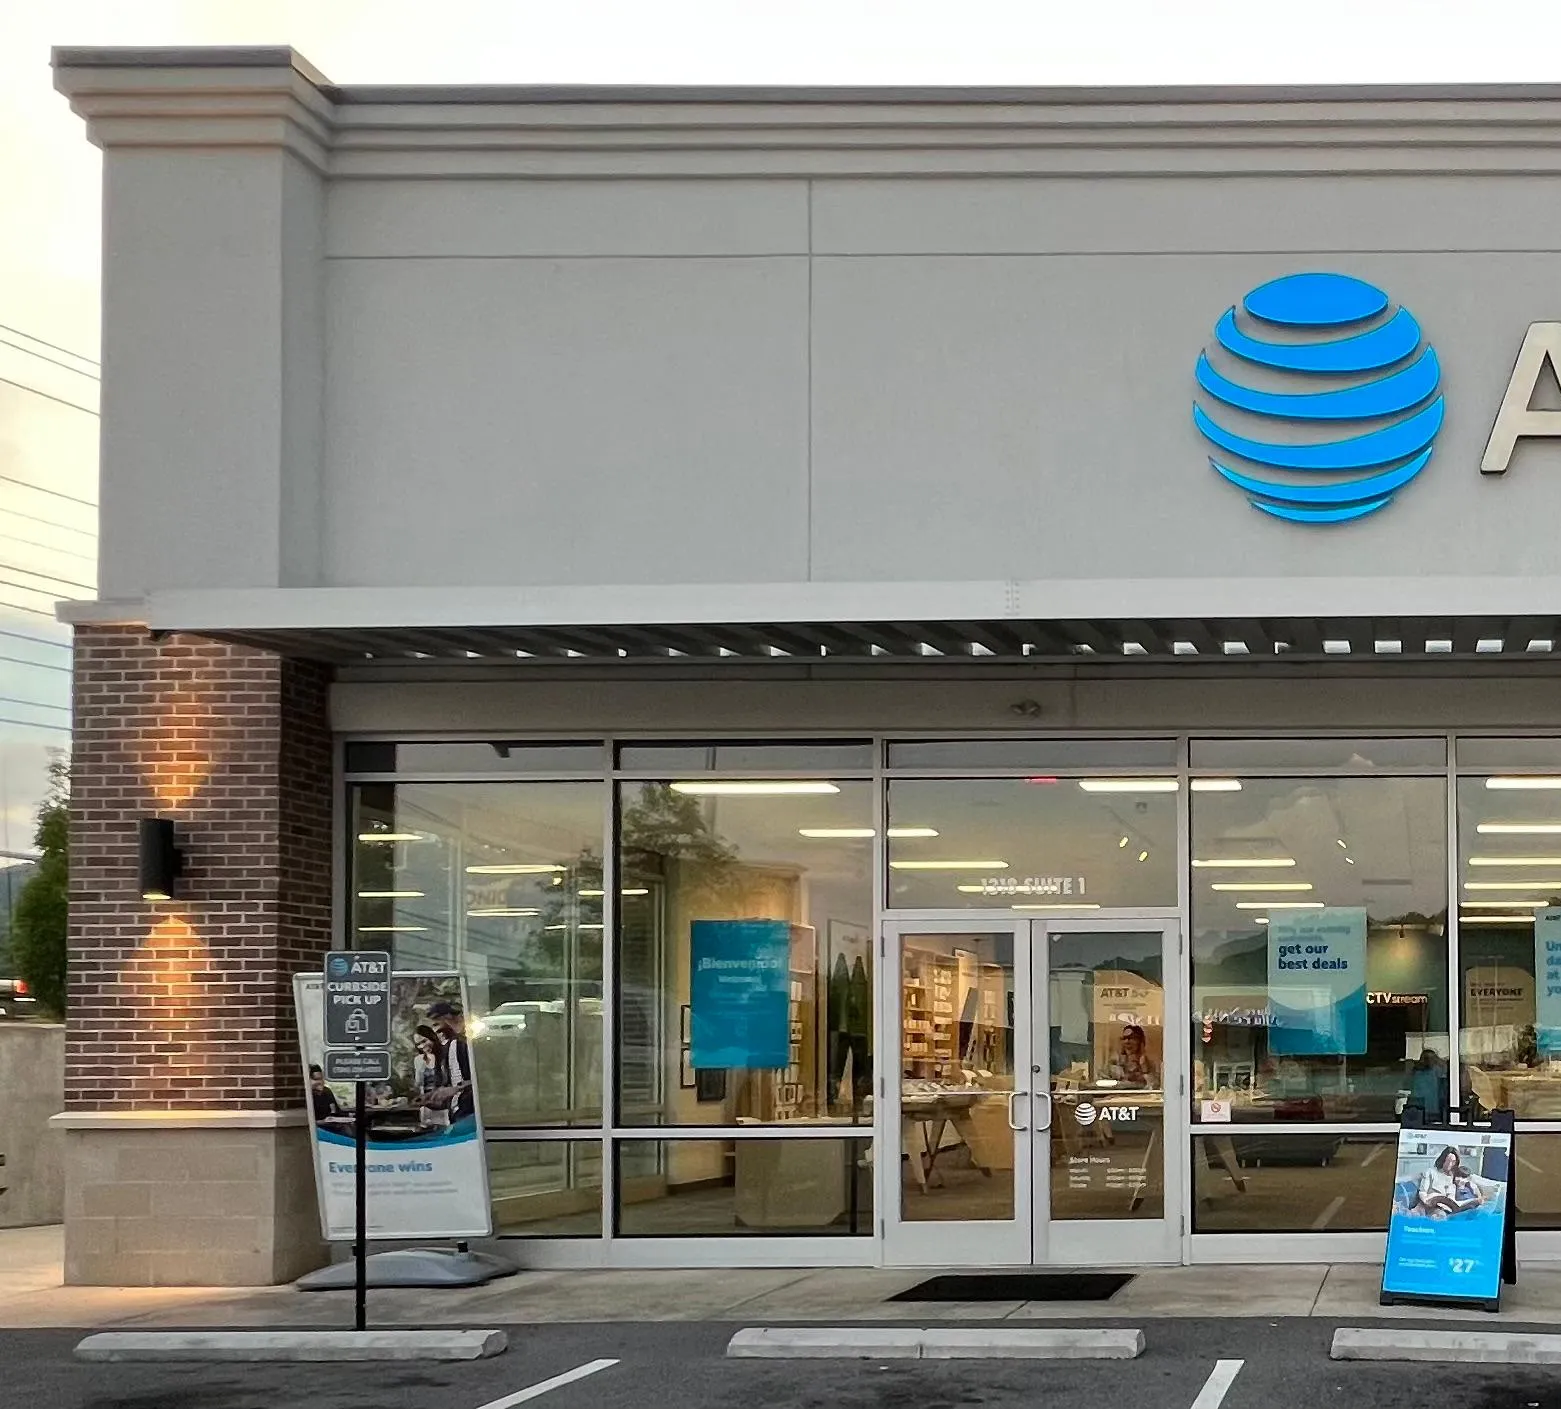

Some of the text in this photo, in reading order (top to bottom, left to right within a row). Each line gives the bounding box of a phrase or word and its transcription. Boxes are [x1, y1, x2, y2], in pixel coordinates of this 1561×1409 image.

[1078, 877, 1086, 895] 1
[1278, 944, 1329, 958] get our
[351, 961, 386, 974] AT&T
[1278, 957, 1348, 970] best deals
[1546, 970, 1560, 981] at
[327, 981, 388, 992] CURBSIDE
[1100, 987, 1130, 998] AT&T
[333, 994, 382, 1005] PICK UP
[1098, 1106, 1140, 1121] AT&T
[398, 1159, 433, 1173] wins
